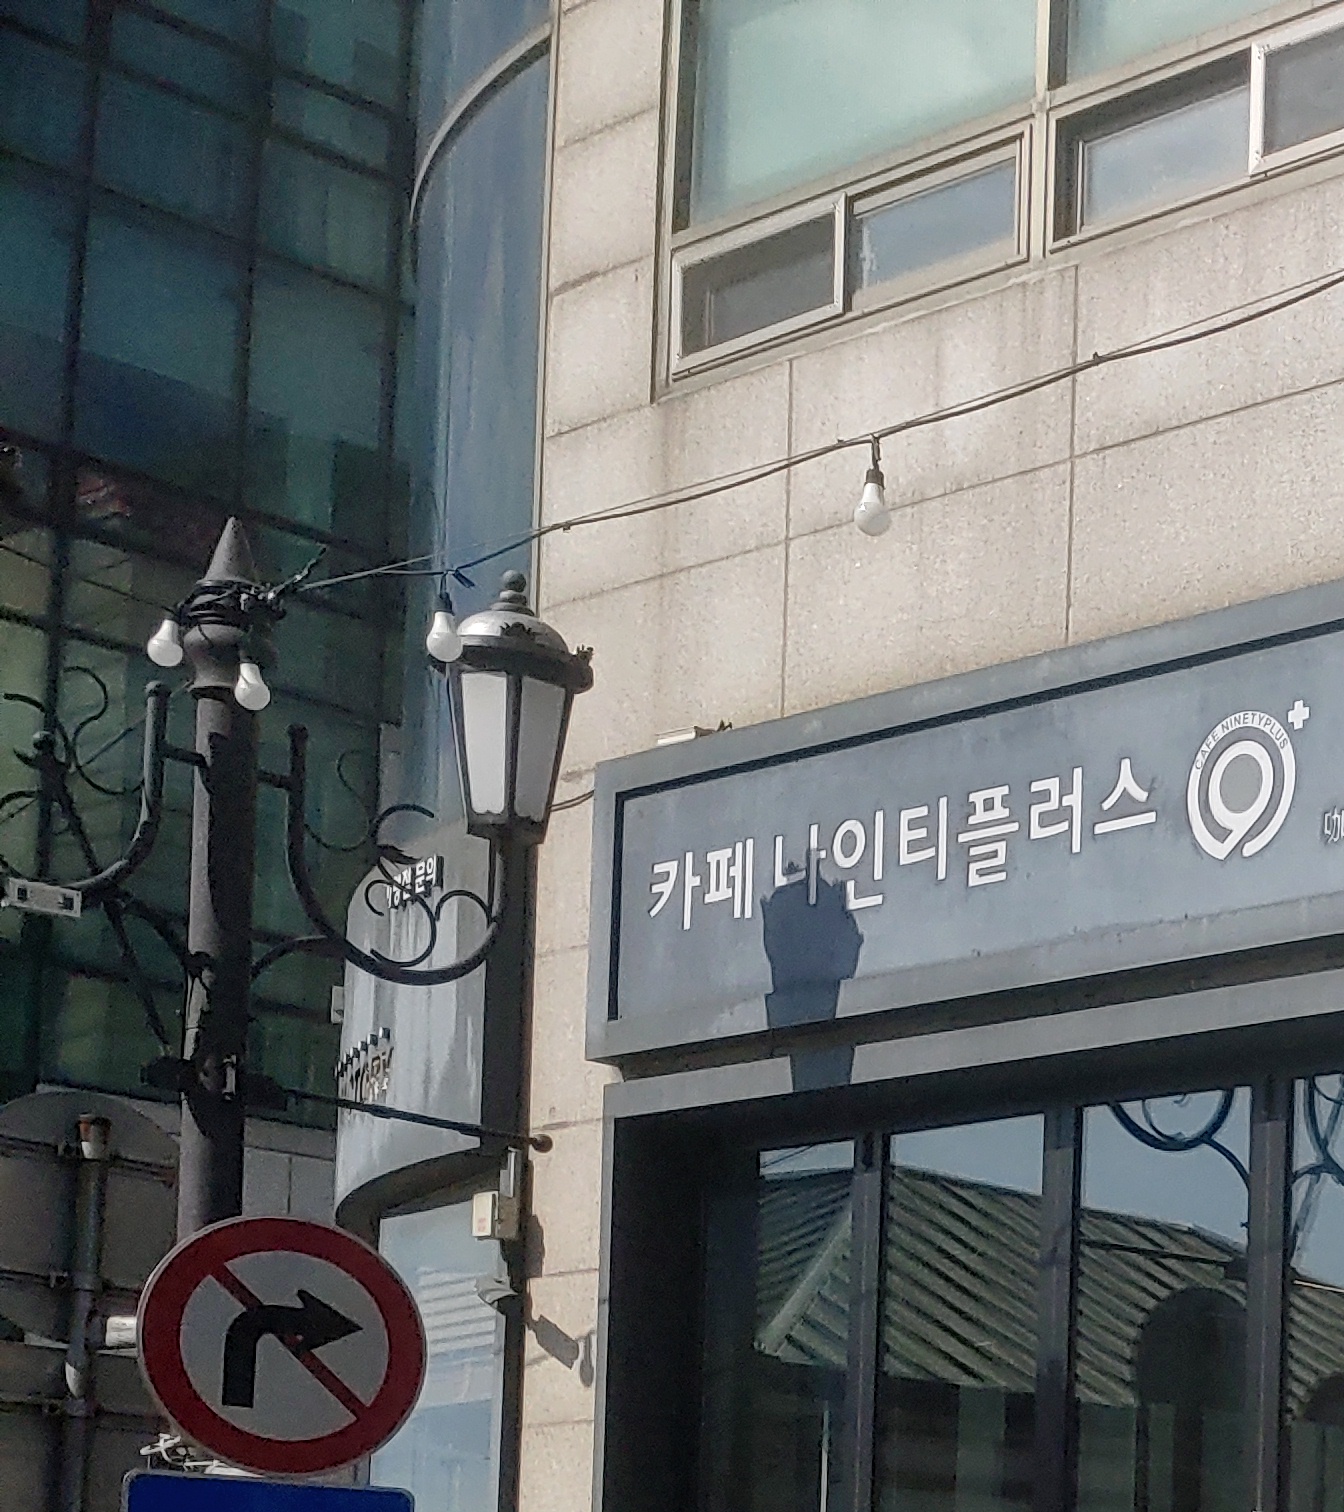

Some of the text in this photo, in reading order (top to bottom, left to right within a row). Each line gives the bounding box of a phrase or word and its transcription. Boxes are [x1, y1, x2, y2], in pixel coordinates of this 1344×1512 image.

[1221, 712, 1289, 750] NINETYPLUS
[648, 757, 1158, 931] 카페 나인티플러스
